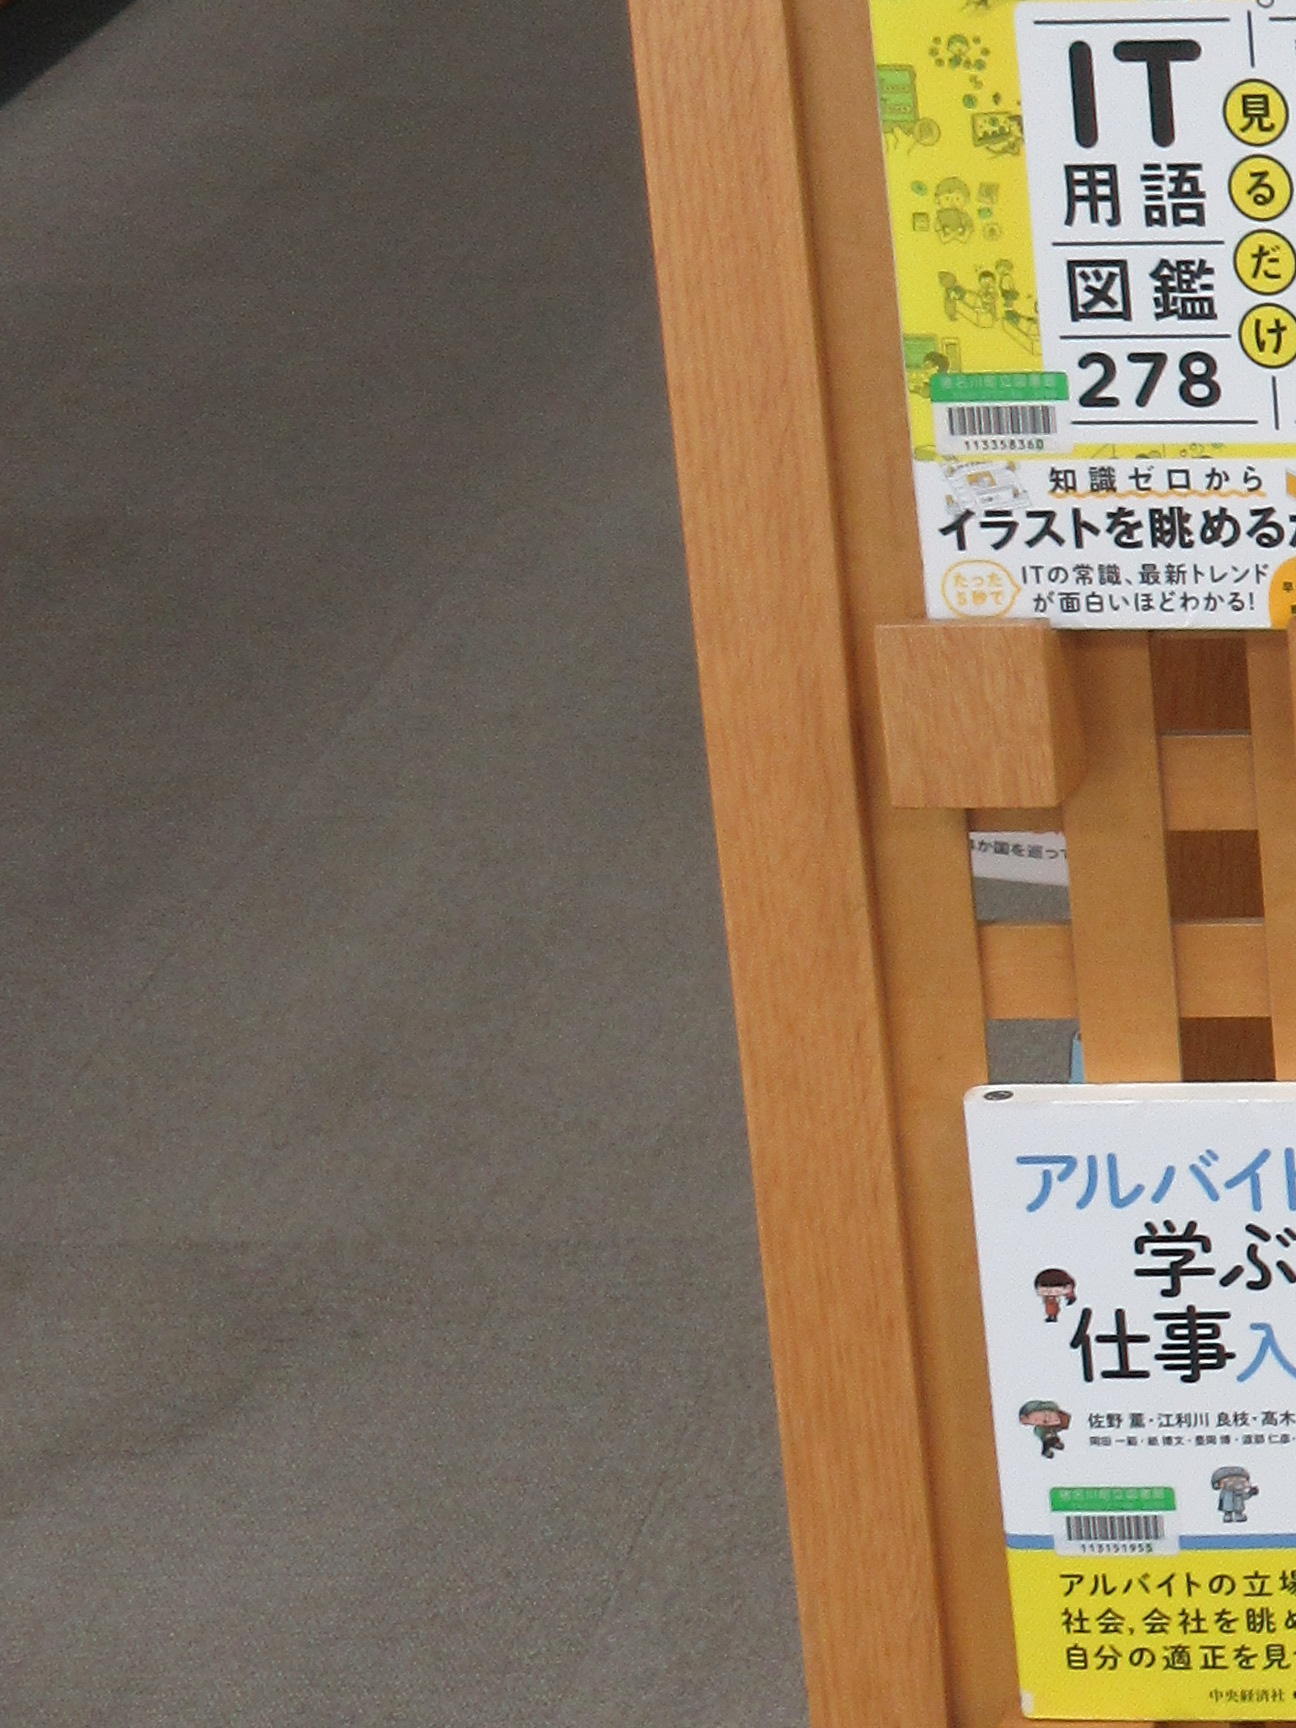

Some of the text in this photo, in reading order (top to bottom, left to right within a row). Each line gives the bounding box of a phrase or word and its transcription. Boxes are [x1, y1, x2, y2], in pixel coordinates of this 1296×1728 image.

[1068, 39, 1202, 149] IT
[1064, 163, 1207, 228] 用語
[1240, 93, 1289, 356] 見るだけ
[1065, 258, 1219, 323] 図鑑
[1078, 351, 1222, 409] 278
[1048, 465, 1264, 494] 知識ゼロから
[1021, 562, 1270, 587] ITの常識、最新トレンド
[1032, 590, 1257, 614] が面白いほどわかる!
